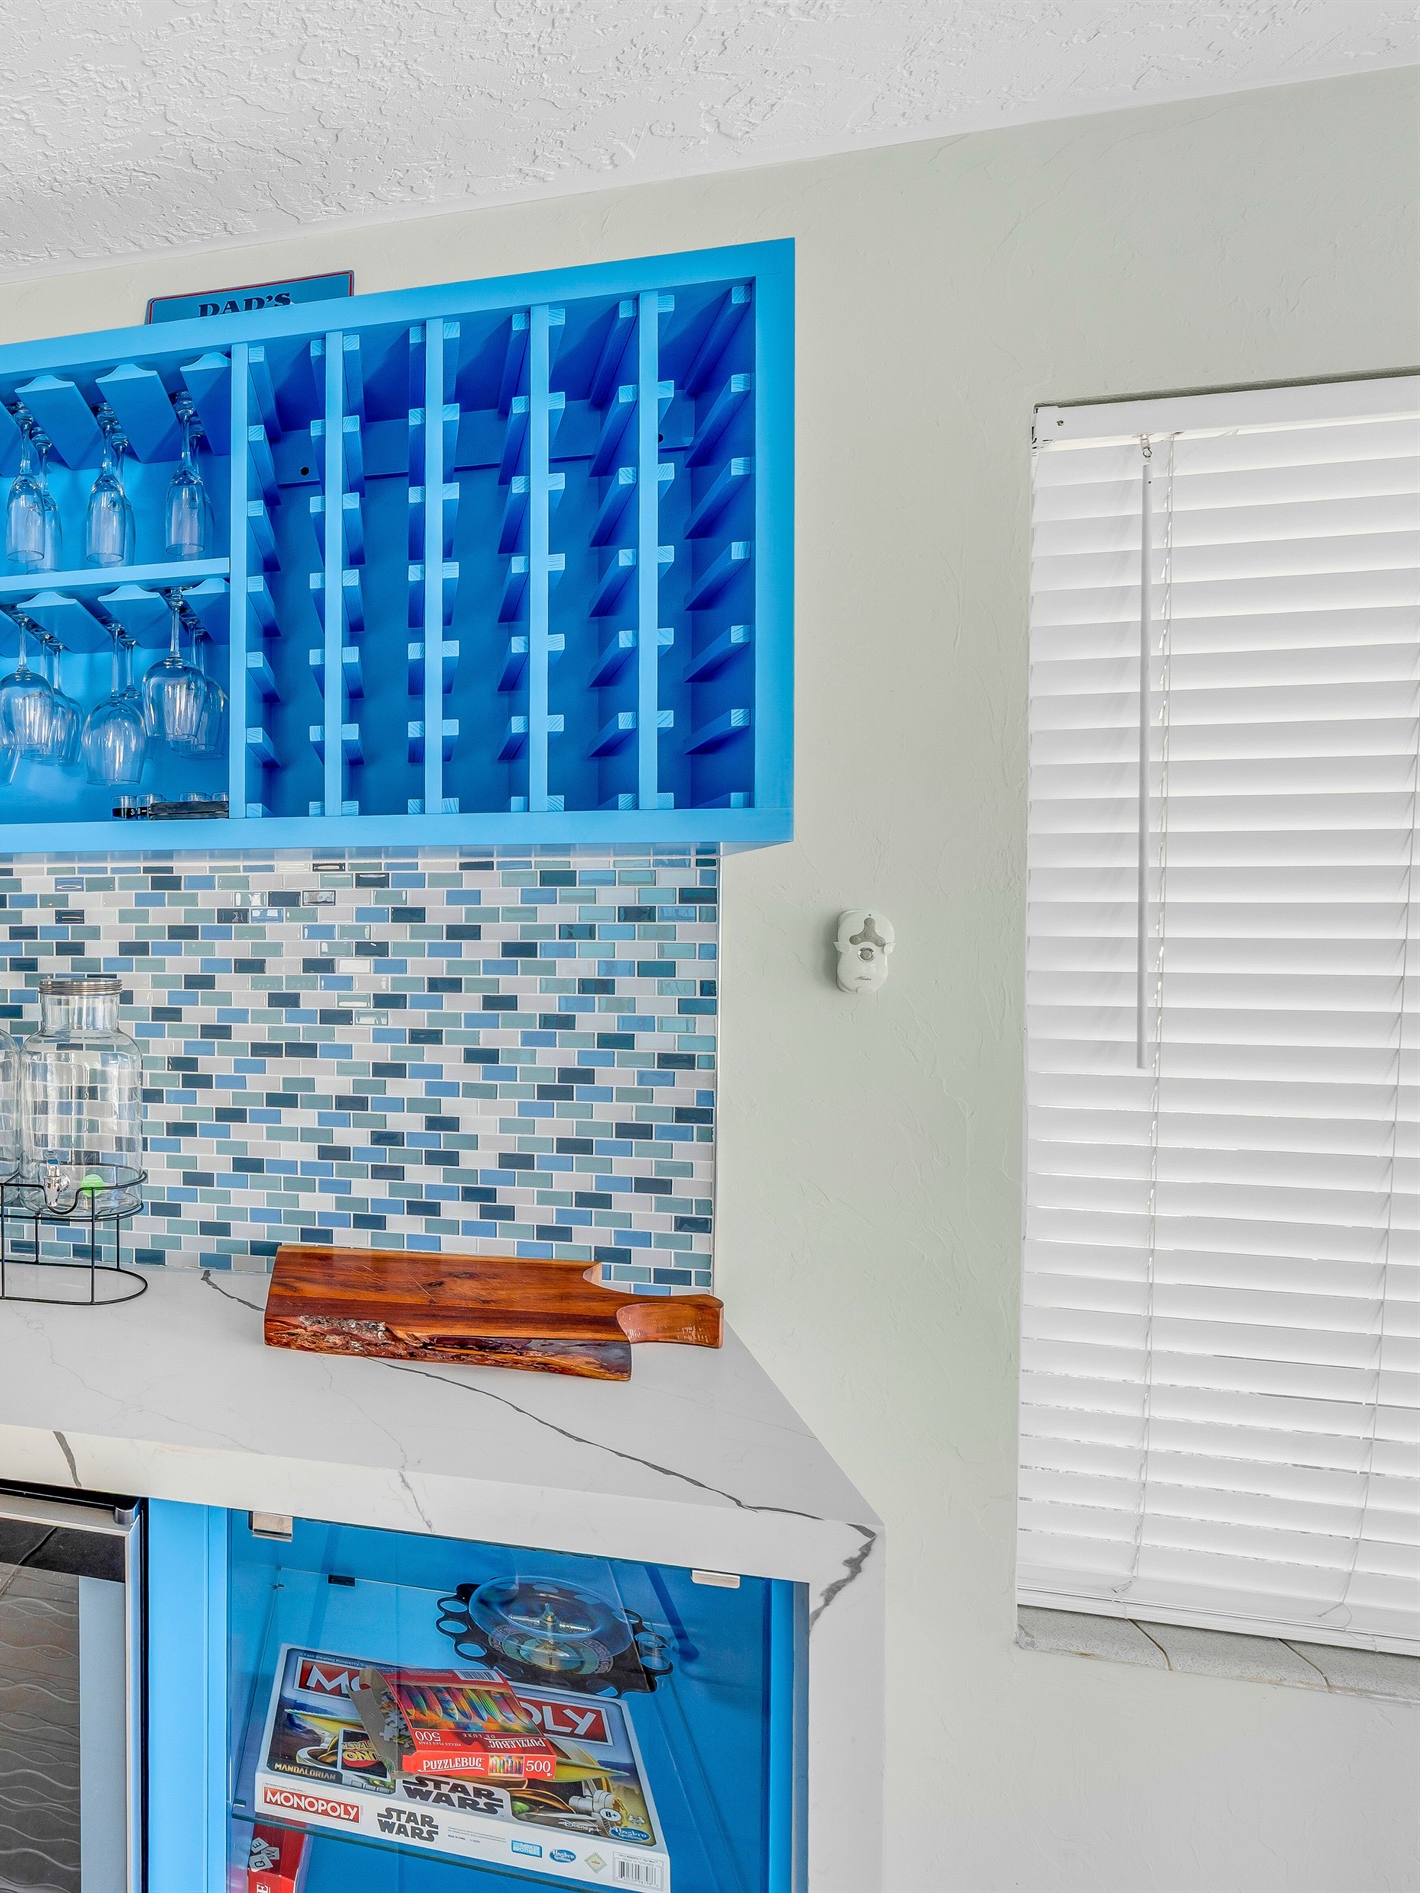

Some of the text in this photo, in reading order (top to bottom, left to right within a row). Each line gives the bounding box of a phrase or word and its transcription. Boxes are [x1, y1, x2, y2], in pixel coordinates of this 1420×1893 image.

[198, 292, 291, 318] DAD'S
[415, 1730, 440, 1742] 500
[490, 1738, 546, 1749] PUZZLEBUG
[274, 1762, 336, 1781] MANDALORIAN
[423, 1757, 482, 1771] PUZZLEBUG
[525, 1759, 551, 1773] 500
[402, 1775, 503, 1803] STAR
[265, 1788, 359, 1820] MONOPOLY
[403, 1785, 504, 1815] WARS
[377, 1807, 439, 1829] STAR
[605, 1810, 617, 1818] 8+
[377, 1819, 439, 1843] WARS
[614, 1826, 648, 1838] Hasbro
